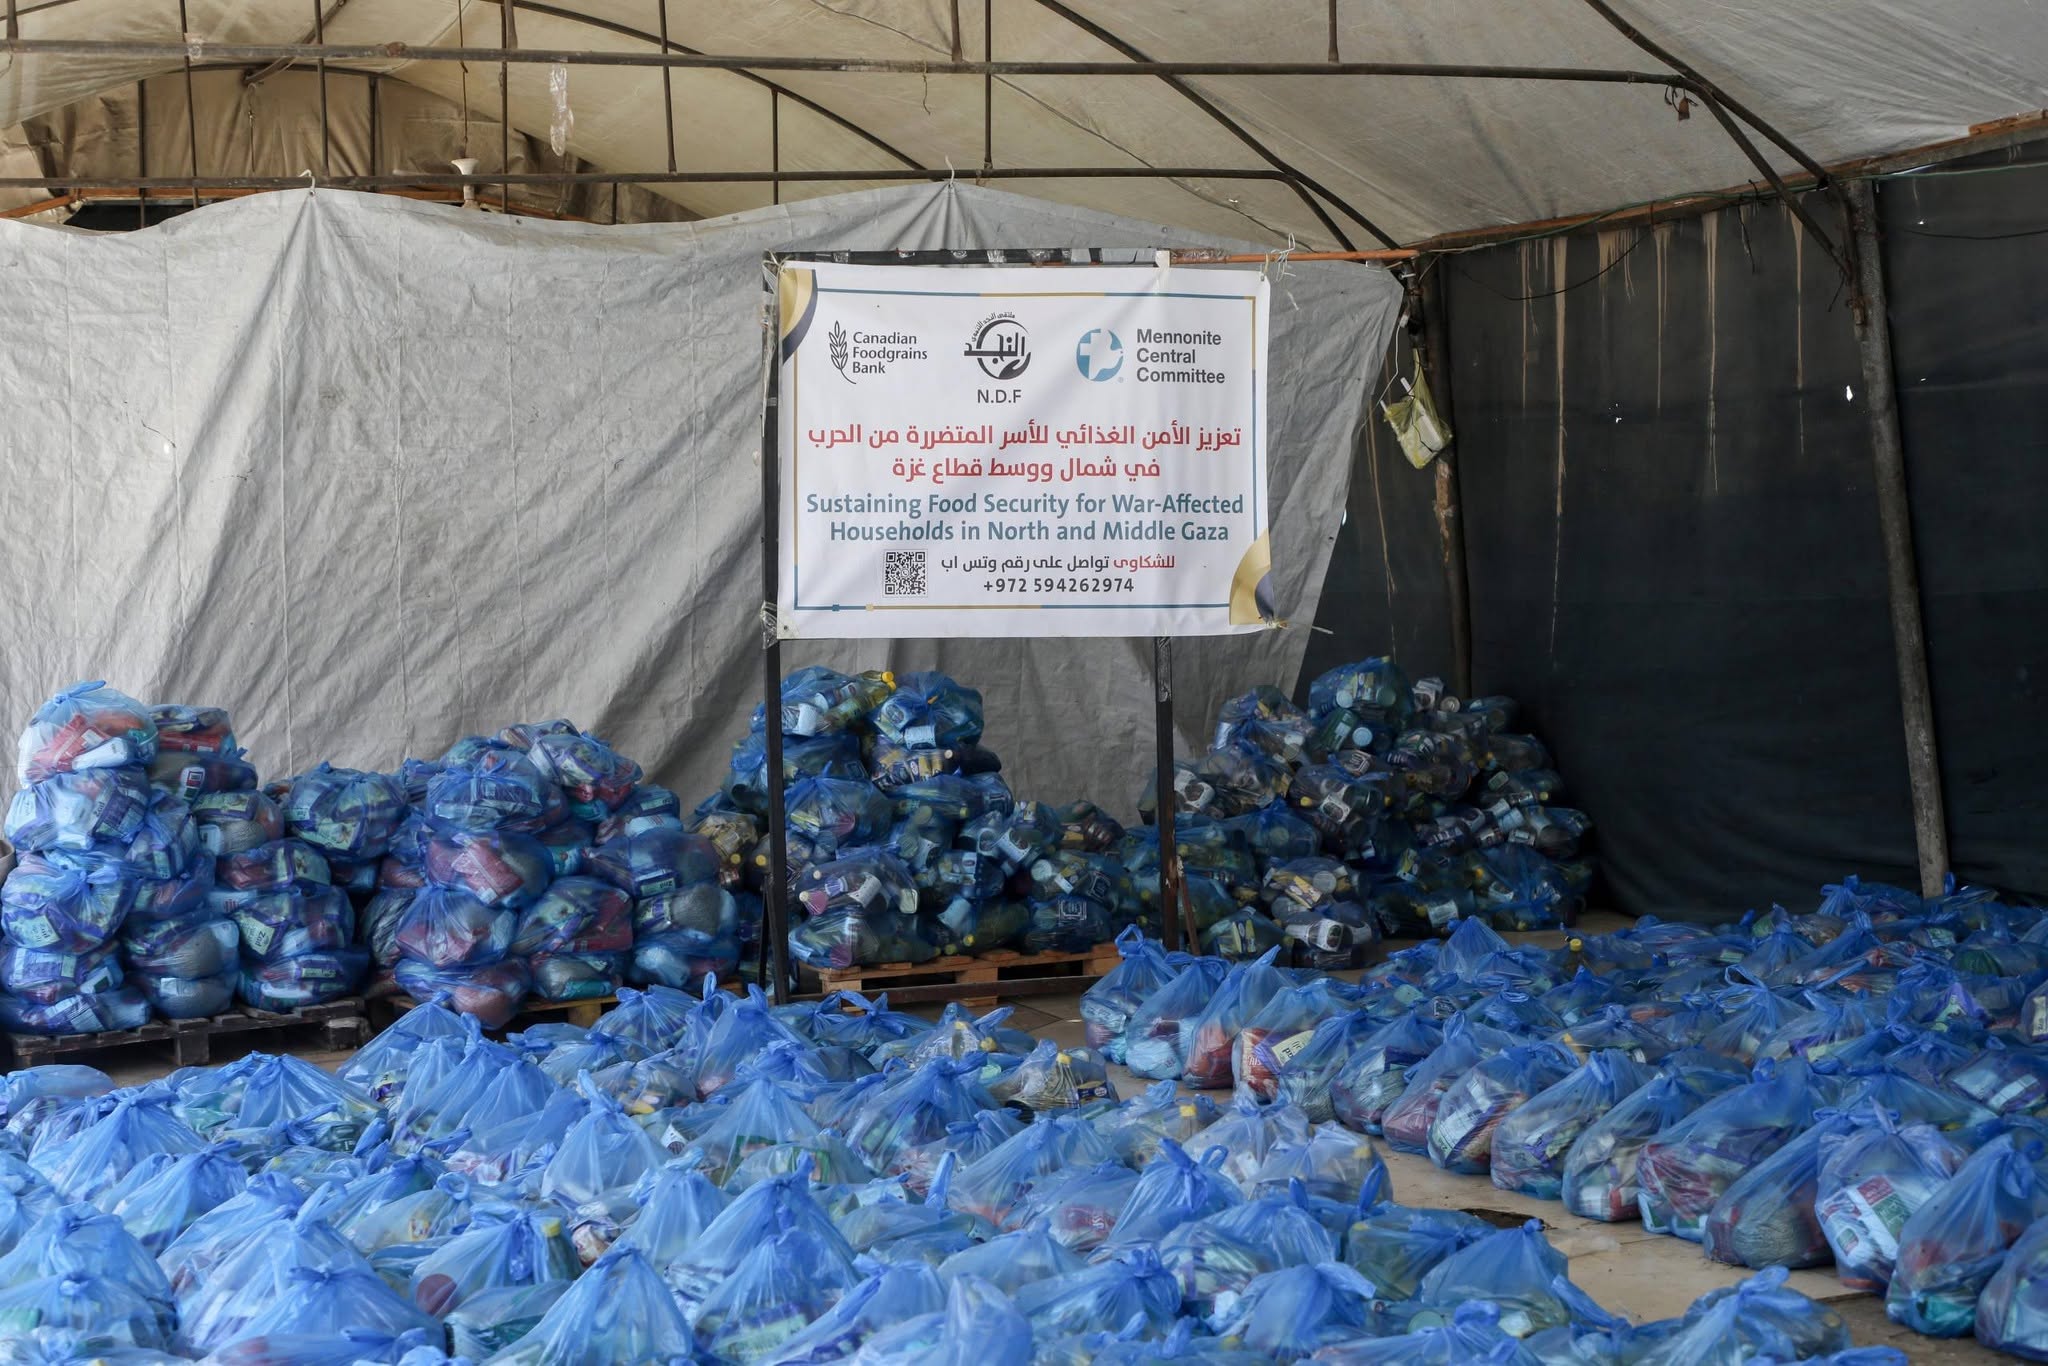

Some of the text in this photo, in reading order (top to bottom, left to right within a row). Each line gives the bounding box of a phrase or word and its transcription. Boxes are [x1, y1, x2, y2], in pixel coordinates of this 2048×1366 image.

[853, 332, 917, 344] Canadian
[1137, 328, 1221, 345] Mennonite
[853, 346, 928, 362] Foodgrains
[1137, 347, 1195, 364] Central
[853, 361, 887, 374] Bank
[1137, 367, 1225, 384] Committee
[978, 389, 1021, 403] N.D.F
[809, 419, 1241, 451] تعزيز الأمن الغذائي للأسر المتضررة من الحرب
[893, 455, 1161, 485] في شمال ووسط قطاع غزة
[807, 492, 1243, 518] Sustaining Food Security for War-Affected
[831, 520, 1228, 541] Households in North and Middle Gaza
[941, 554, 1175, 573] للشكاوى تواصل على رقم وتس اب
[984, 578, 1135, 593] +972 594262974
